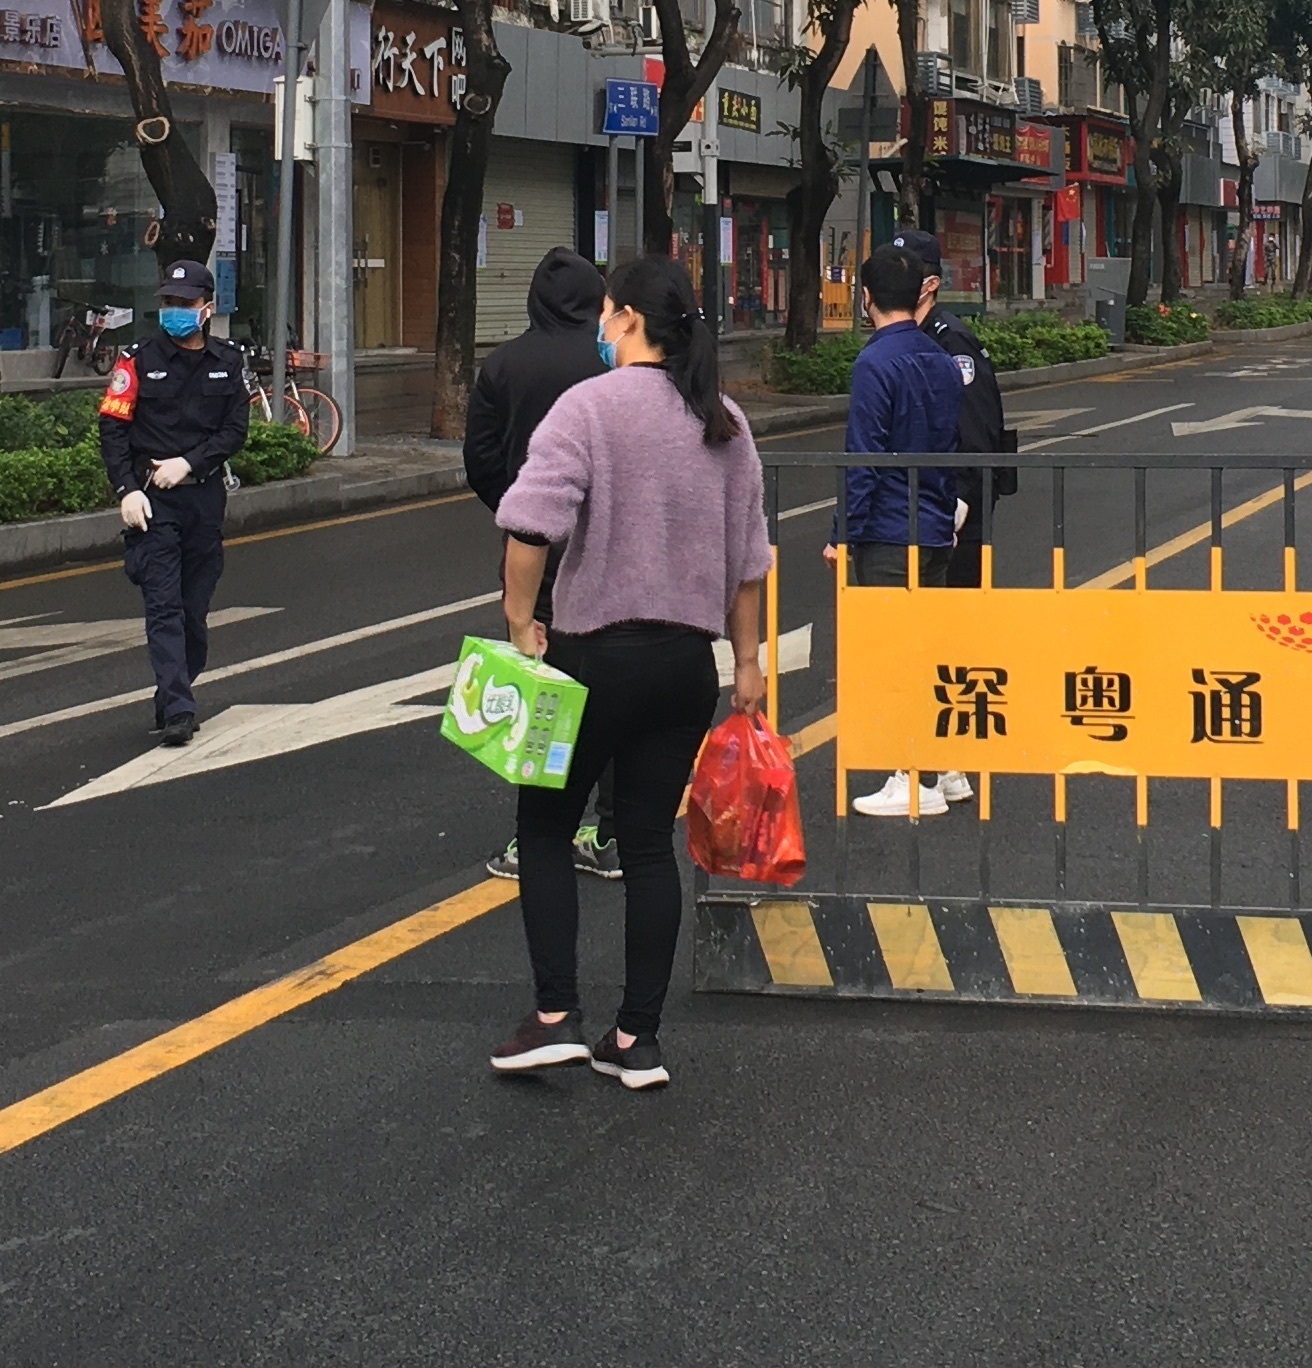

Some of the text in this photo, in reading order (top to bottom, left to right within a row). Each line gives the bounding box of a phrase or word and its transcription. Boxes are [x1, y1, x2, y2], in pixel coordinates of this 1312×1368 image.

[451, 26, 467, 110] 网吧
[933, 100, 949, 156] 馄饨米
[932, 664, 1265, 745] 深粤通
